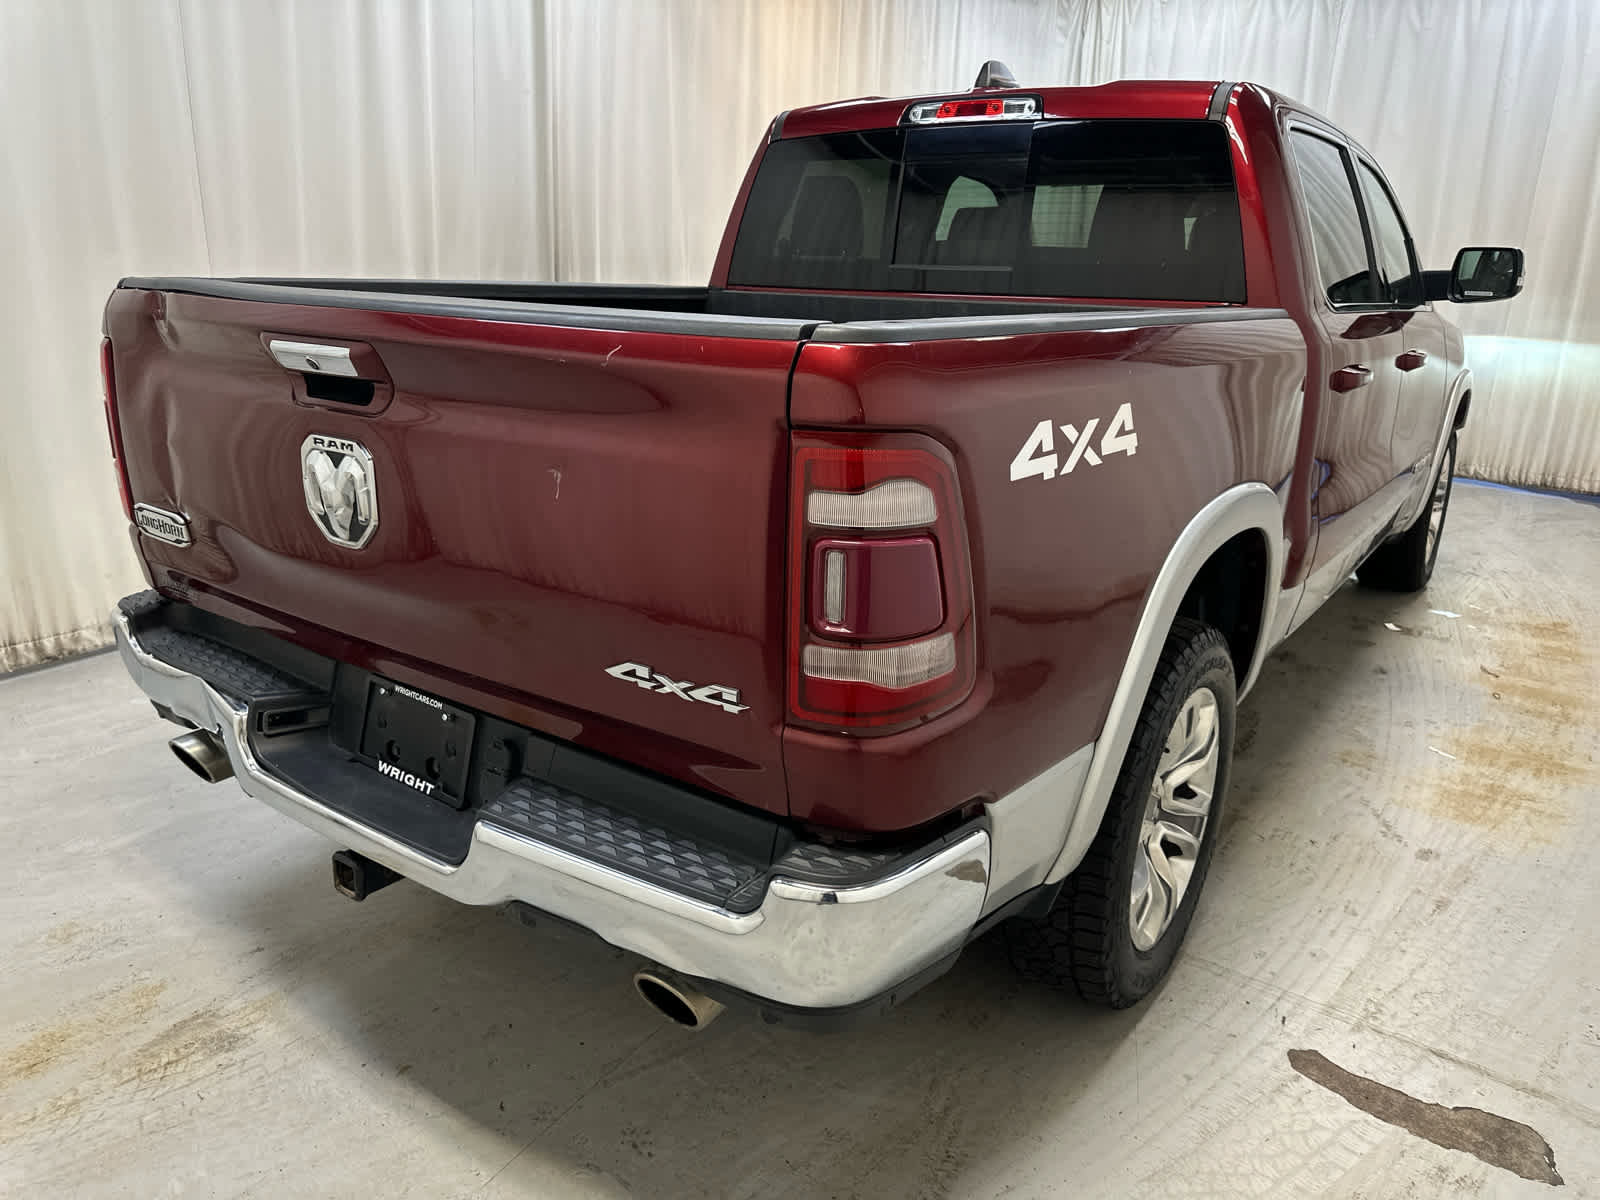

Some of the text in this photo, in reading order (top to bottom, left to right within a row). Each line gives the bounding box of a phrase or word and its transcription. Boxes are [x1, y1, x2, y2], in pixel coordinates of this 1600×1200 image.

[313, 437, 354, 452] RAM
[136, 511, 185, 539] LONGHORN
[394, 685, 443, 710] WRIGHTCARS.COM
[378, 760, 435, 795] WRIGHT
